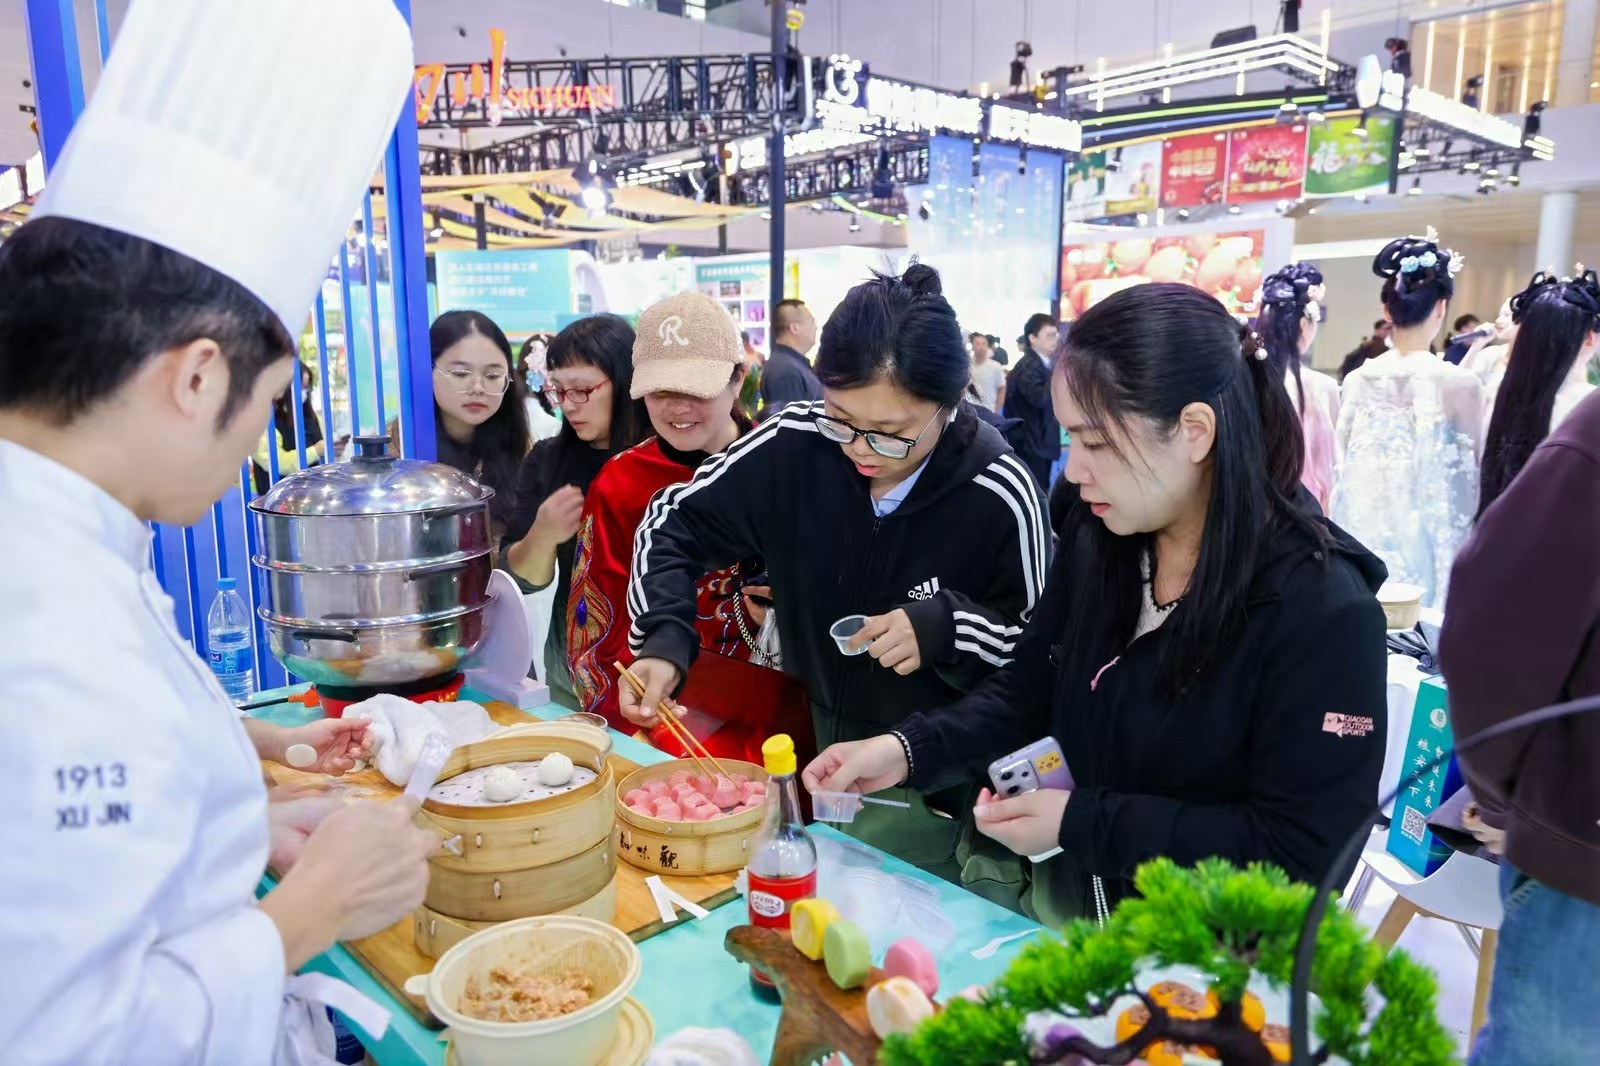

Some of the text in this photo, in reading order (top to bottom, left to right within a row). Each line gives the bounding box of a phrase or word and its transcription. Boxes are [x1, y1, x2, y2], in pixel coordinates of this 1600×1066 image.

[507, 84, 616, 111] SICHUAN
[658, 315, 689, 347] R
[1342, 728, 1366, 737] SPORTS
[1343, 722, 1375, 732] OUTDOOR
[54, 763, 128, 792] 1913
